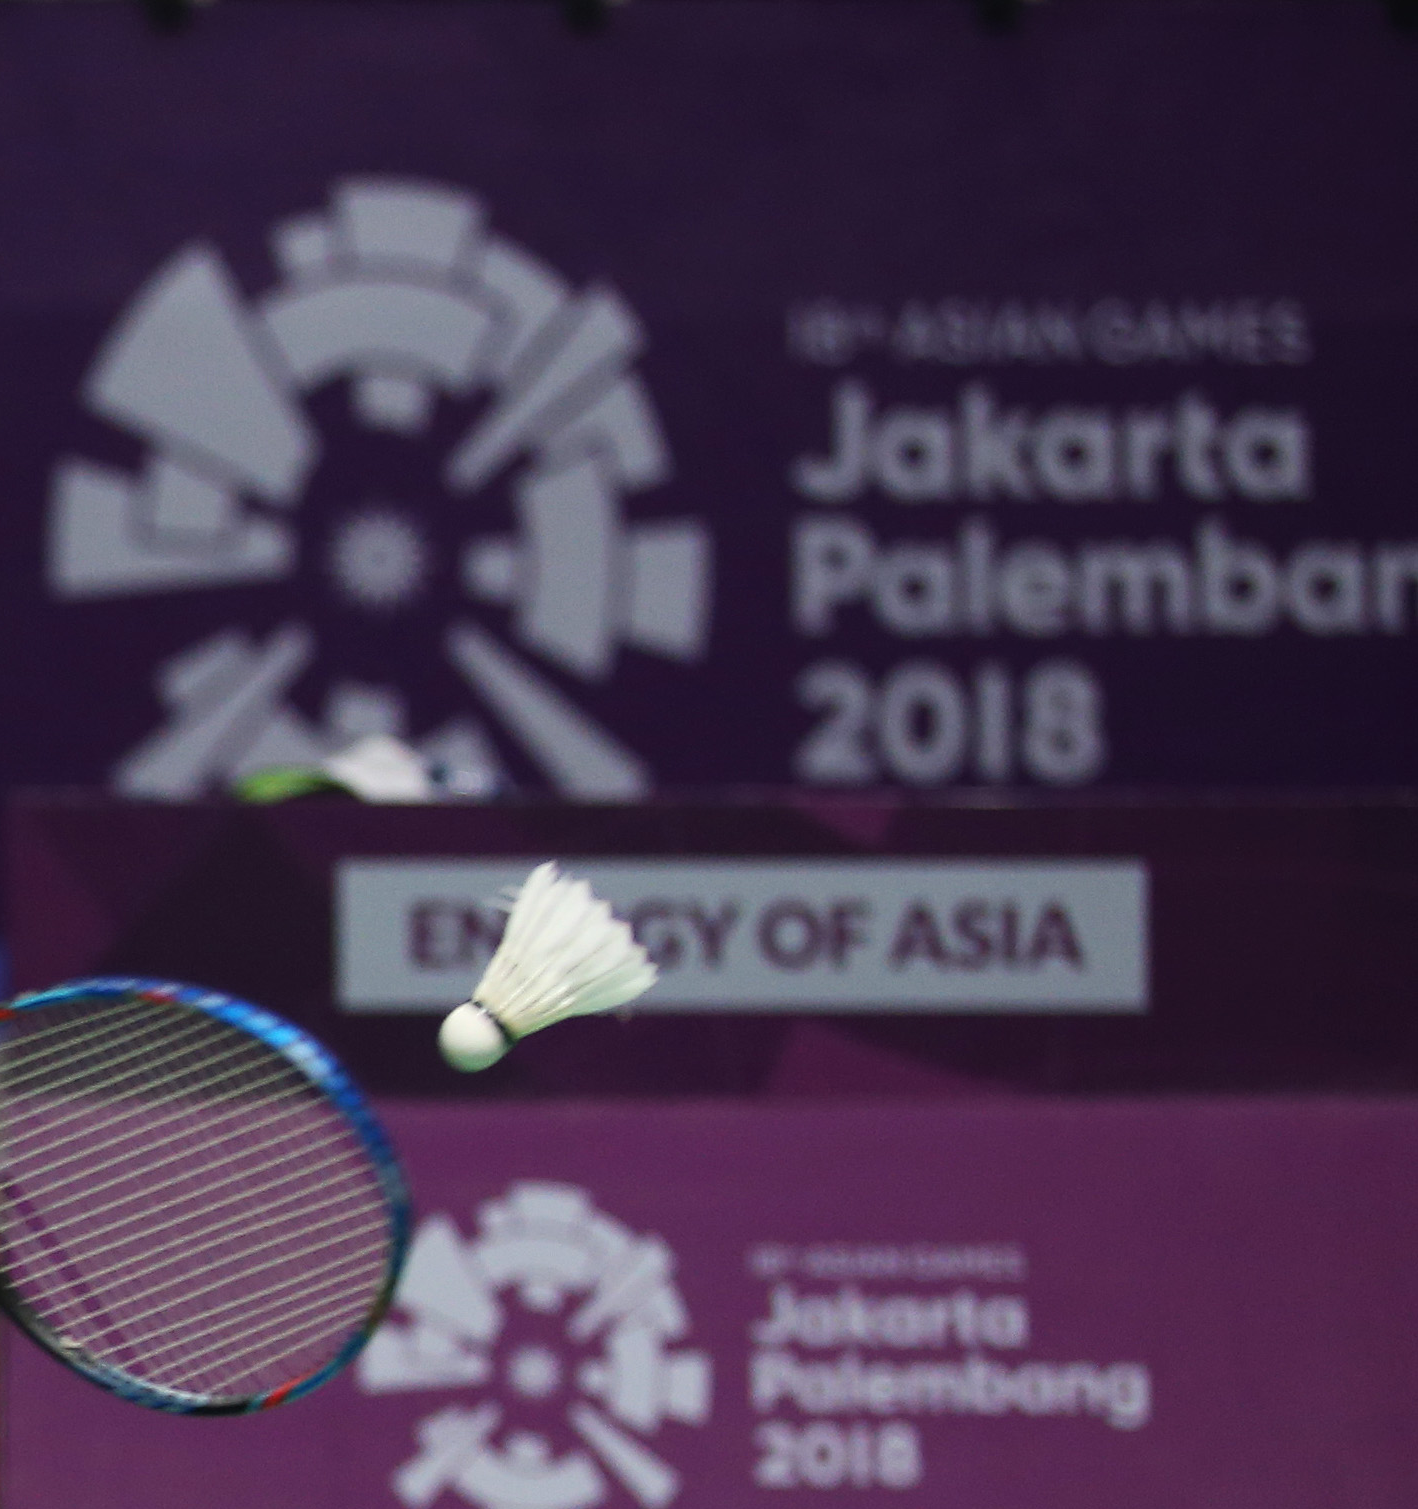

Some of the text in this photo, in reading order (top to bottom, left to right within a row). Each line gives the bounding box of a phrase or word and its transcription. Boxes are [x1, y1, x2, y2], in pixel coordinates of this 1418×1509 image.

[793, 381, 1308, 502] Jakarta
[796, 662, 1104, 784] 2018
[760, 896, 870, 973] OF
[886, 896, 1085, 973] ASIA
[752, 1282, 1029, 1349] Jakarta
[749, 1351, 1151, 1430] Palembang
[755, 1420, 922, 1488] 2018
